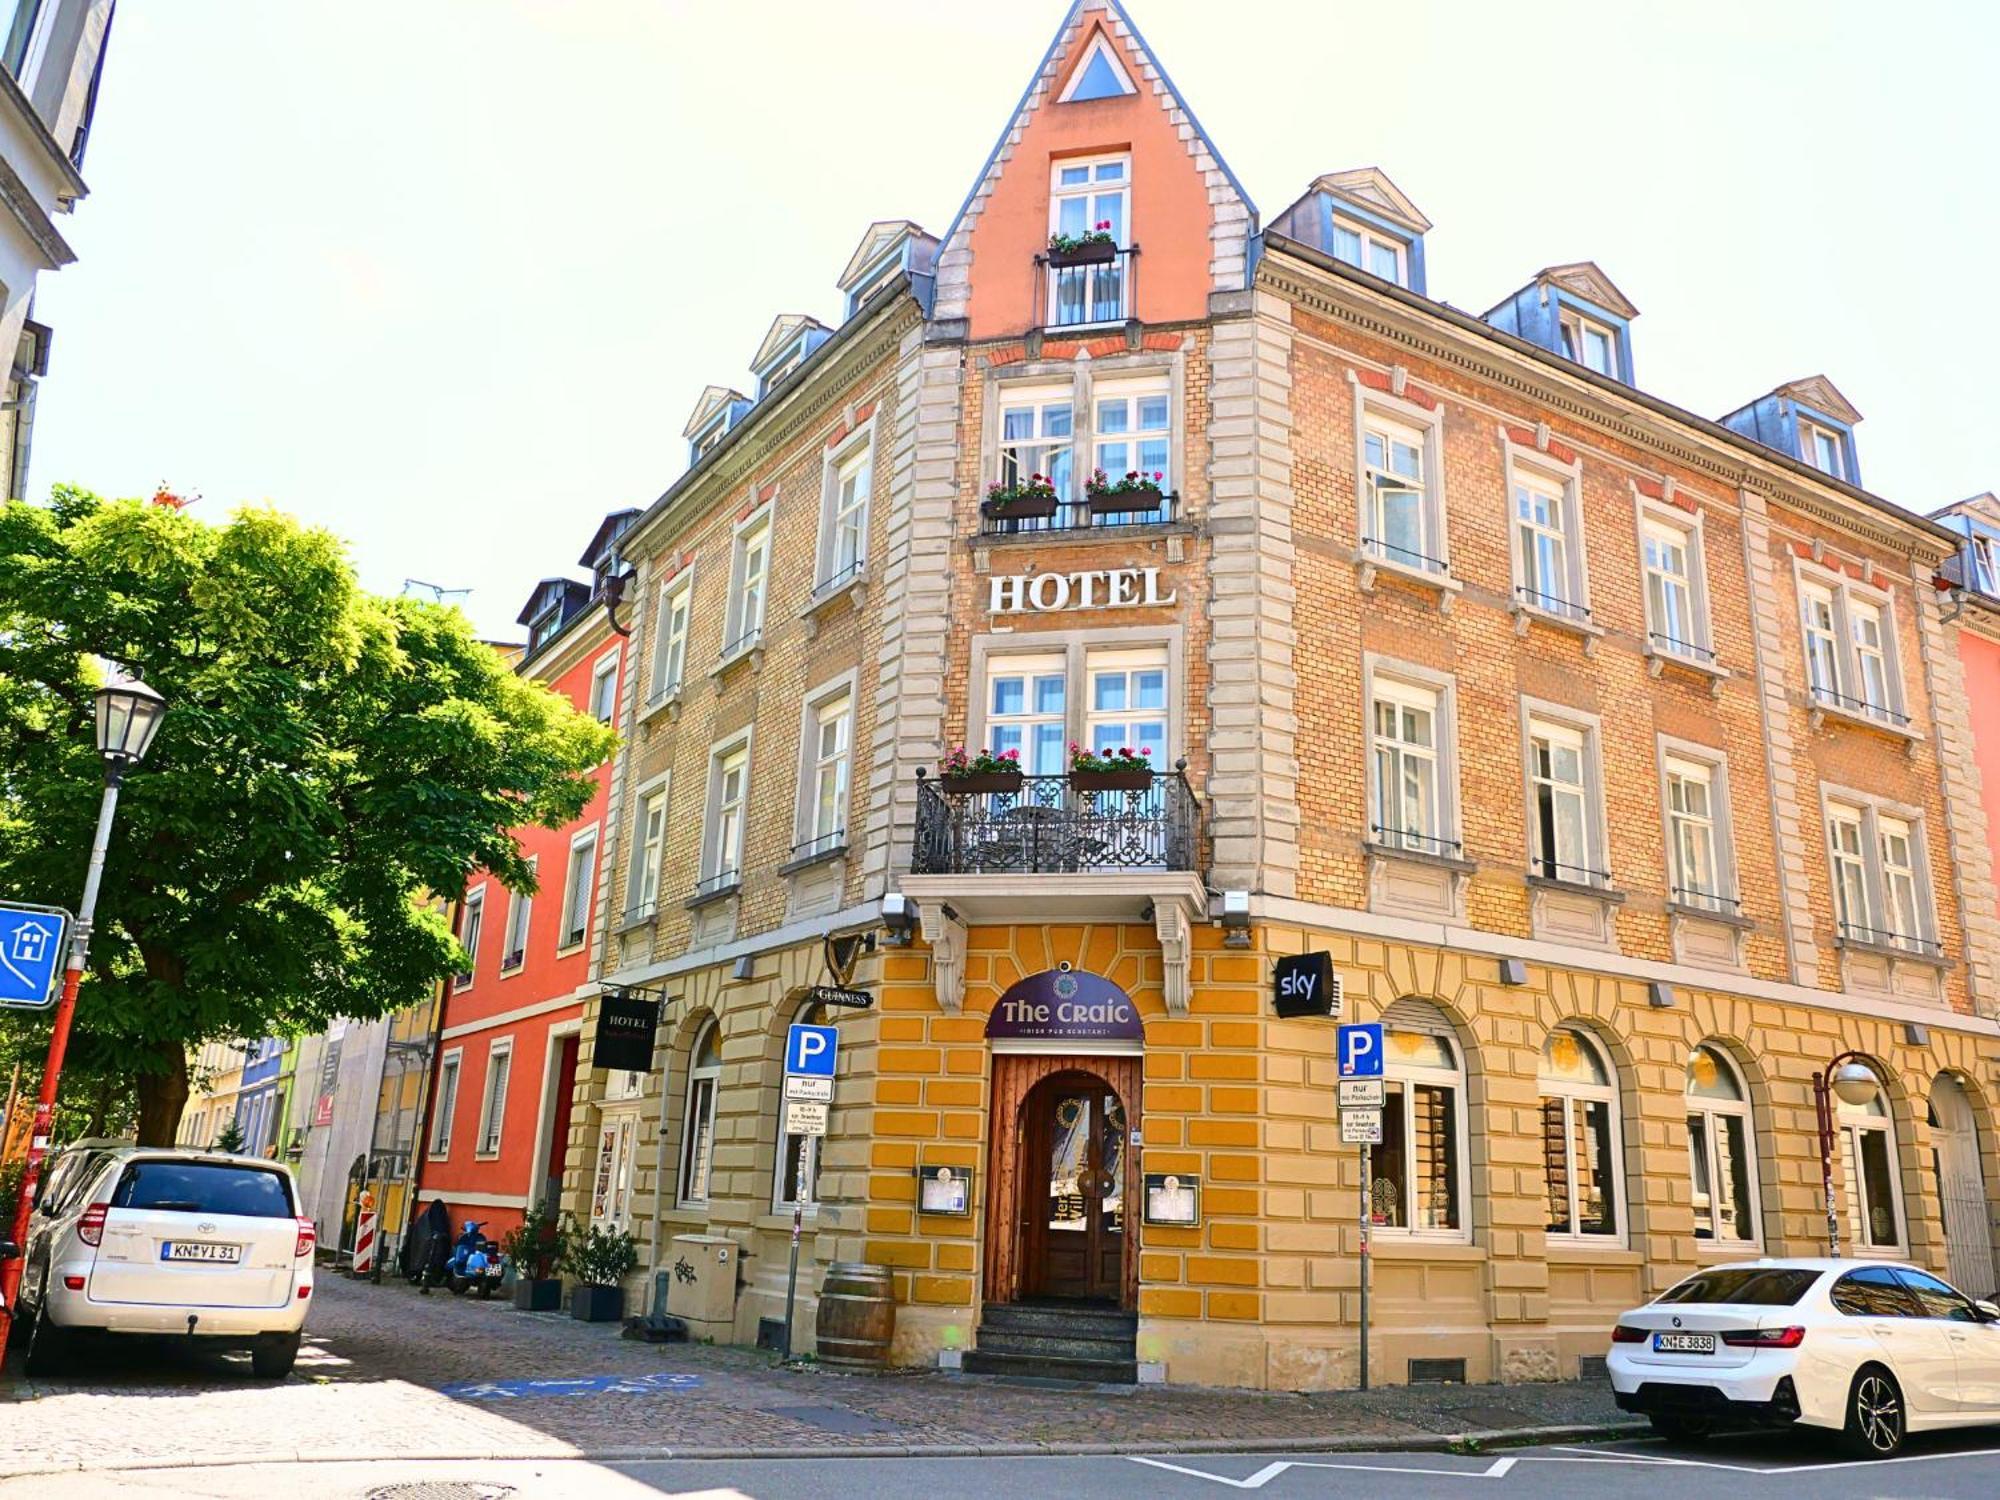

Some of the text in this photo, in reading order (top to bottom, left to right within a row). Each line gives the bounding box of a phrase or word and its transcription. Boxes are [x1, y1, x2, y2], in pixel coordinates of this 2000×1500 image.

[989, 568, 1177, 612] HOTEL
[1281, 968, 1316, 1000] sky
[819, 989, 867, 1005] GUINNESS
[1002, 999, 1050, 1023] The
[609, 1015, 648, 1029] HOTEL
[798, 1031, 827, 1069] P
[1347, 1030, 1373, 1071] P
[802, 1080, 816, 1088] nur
[1352, 1084, 1368, 1092] nur
[175, 1244, 234, 1259] KN YI 31
[1660, 1336, 1712, 1350] KN E 3838
